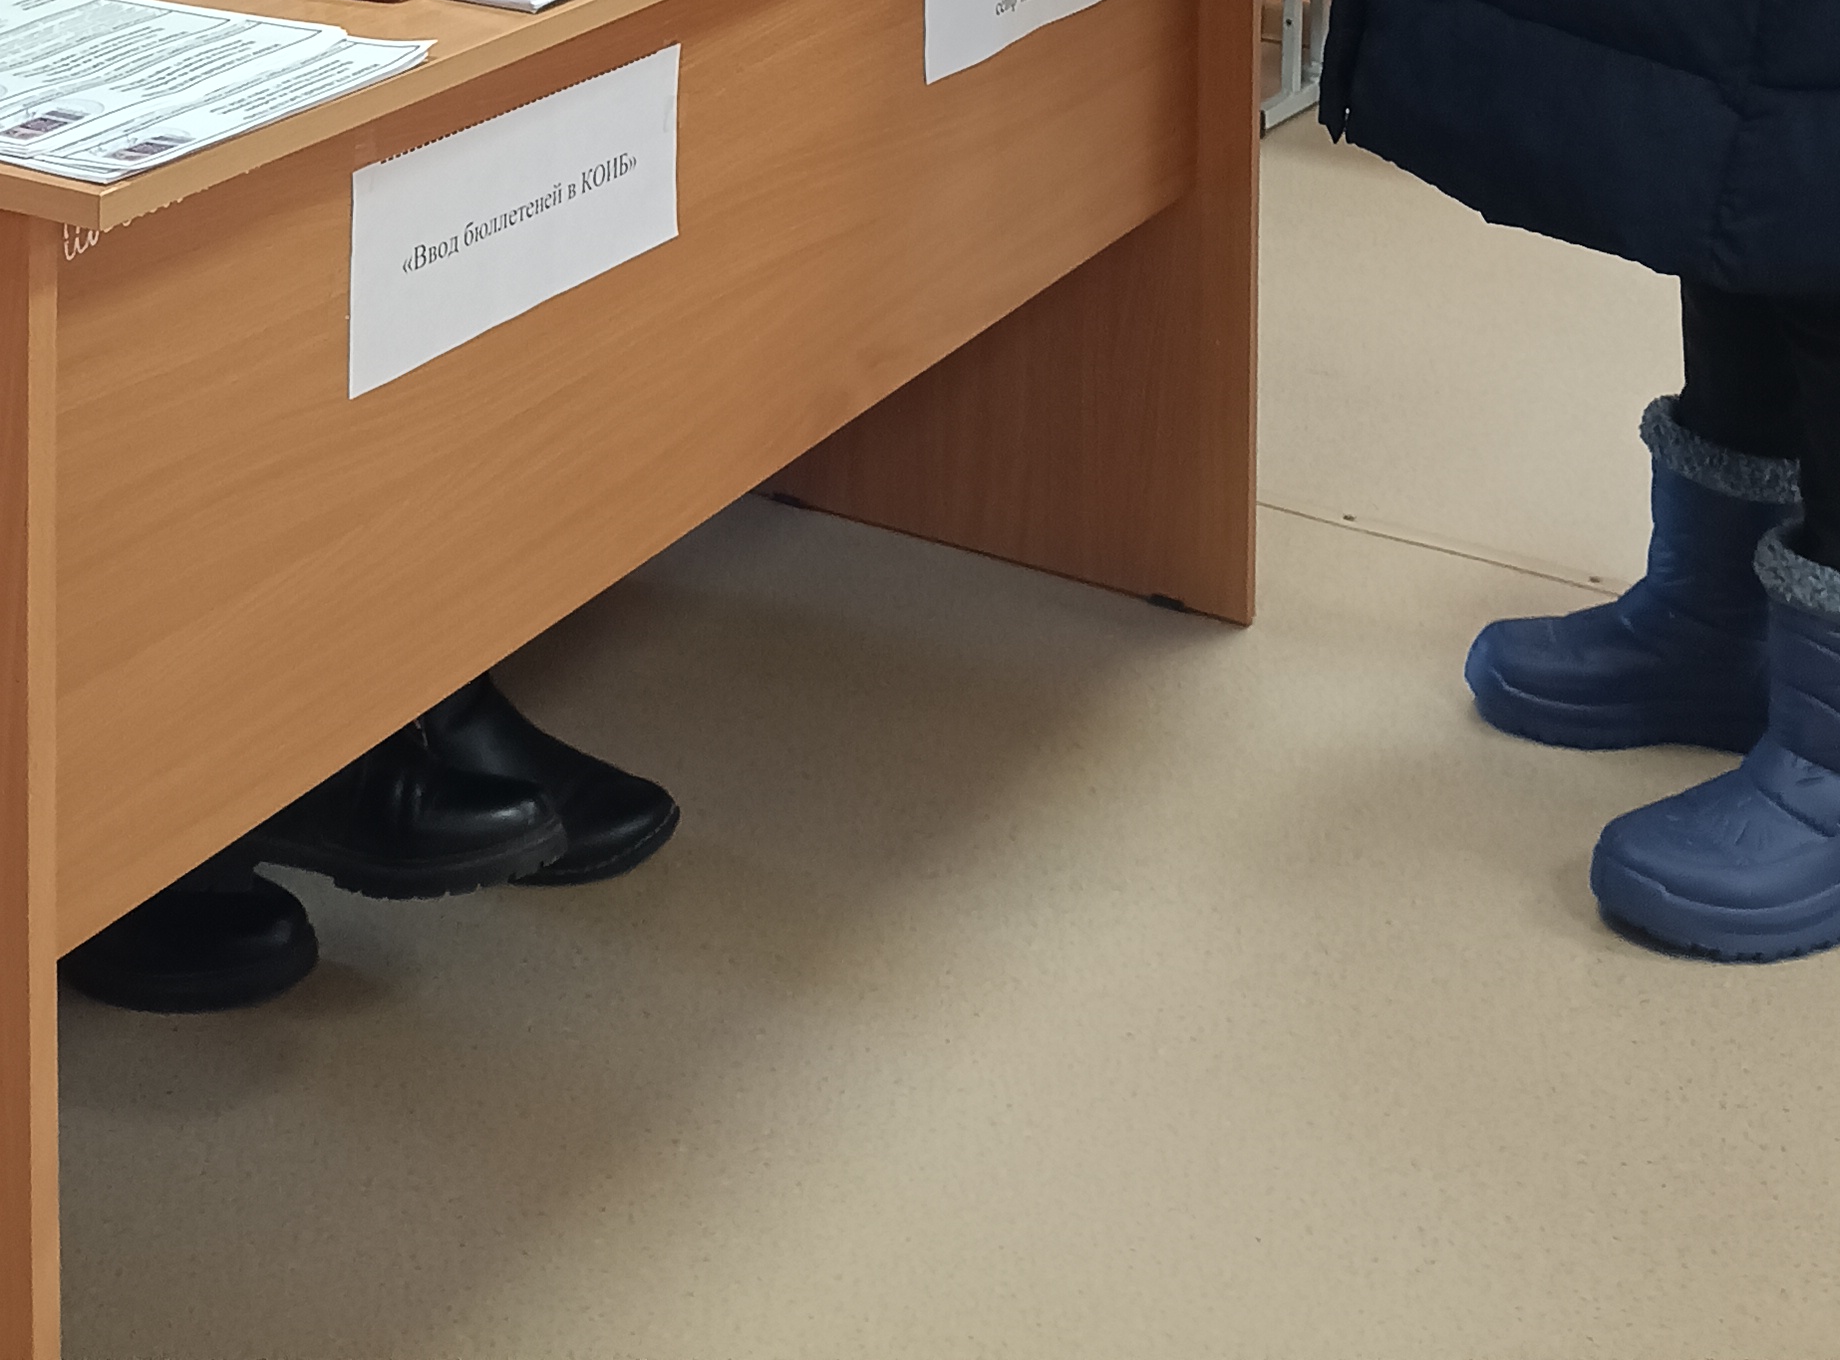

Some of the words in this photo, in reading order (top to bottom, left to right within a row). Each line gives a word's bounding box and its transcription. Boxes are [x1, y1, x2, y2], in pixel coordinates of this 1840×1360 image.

[402, 235, 459, 275] «Ввод
[464, 182, 563, 248] бюллетеней
[567, 182, 577, 200] в
[581, 152, 638, 195] КОИБ»
